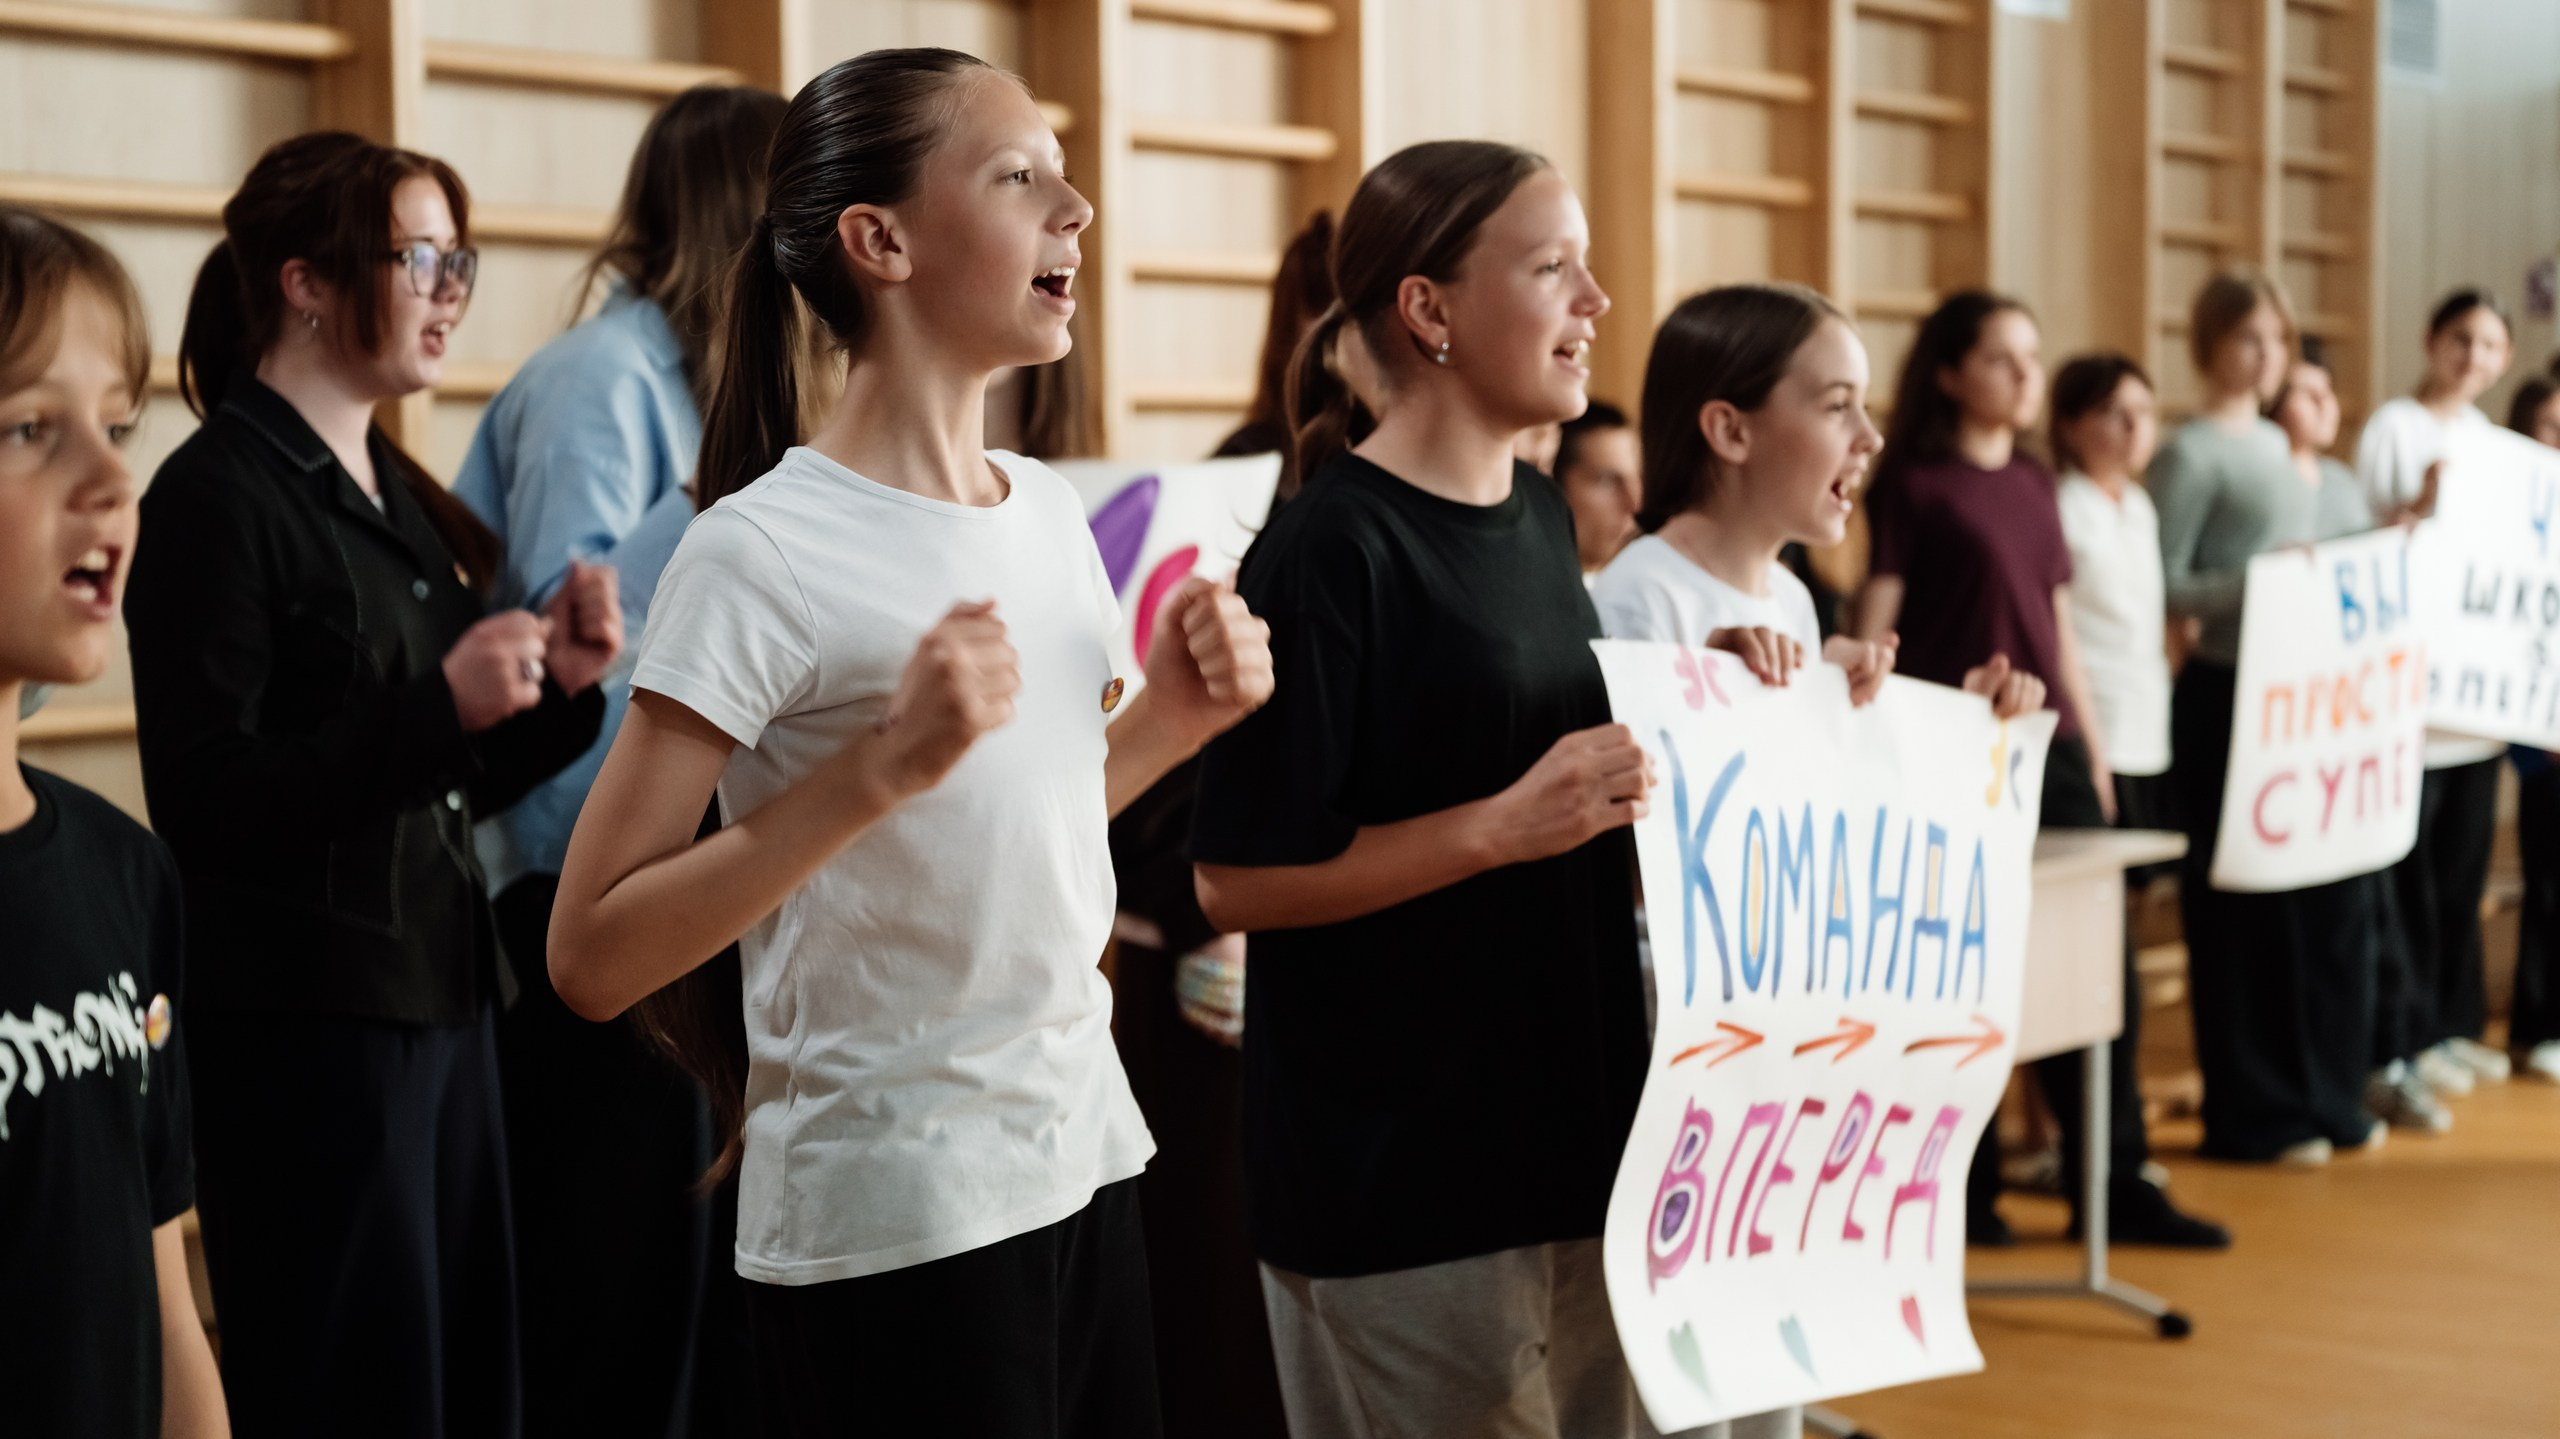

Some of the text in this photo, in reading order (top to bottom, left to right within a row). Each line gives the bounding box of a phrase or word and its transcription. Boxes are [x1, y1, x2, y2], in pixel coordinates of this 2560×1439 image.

[2335, 543, 2408, 645] ВЫ
[1658, 727, 1987, 1008] КОМАНДА
[1647, 1089, 1964, 1295] ВПЕРЕД
